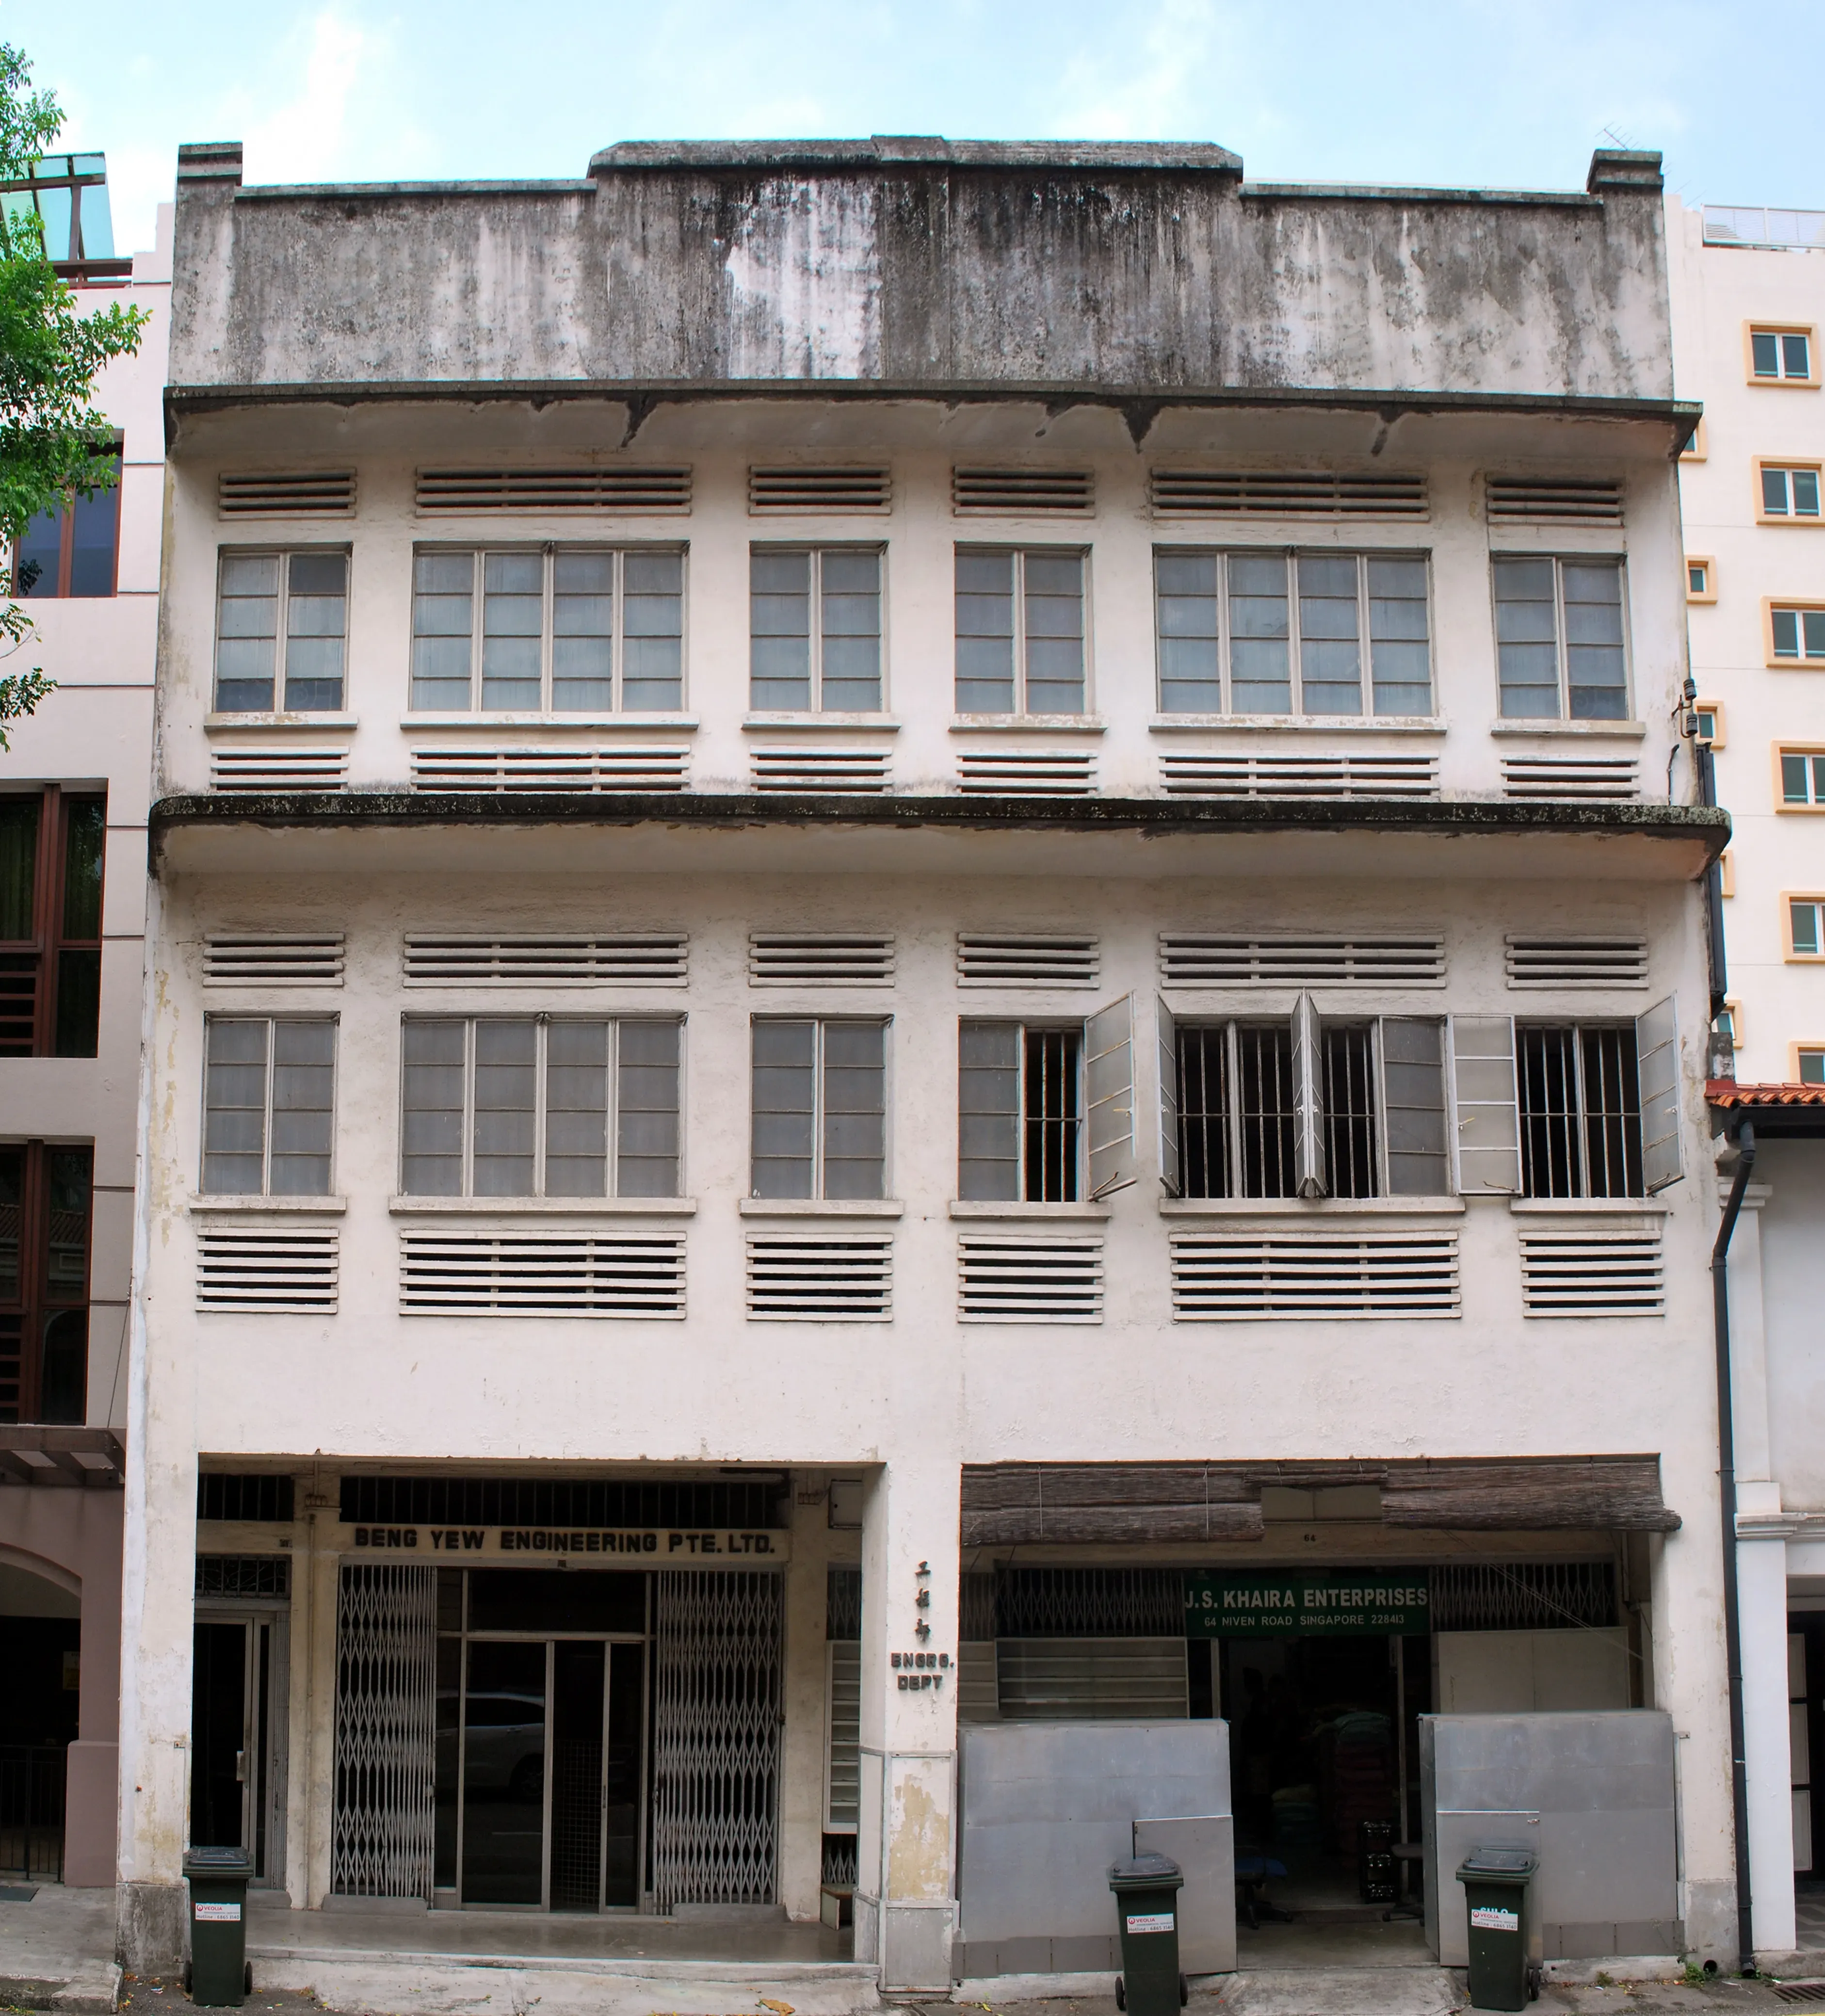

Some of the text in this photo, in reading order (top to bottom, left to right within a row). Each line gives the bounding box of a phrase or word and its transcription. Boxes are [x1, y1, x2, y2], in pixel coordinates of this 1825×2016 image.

[355, 1527, 775, 1553] BENG YEW ENGINEERING PTE. LTD.
[1185, 1587, 1428, 1609] J.S. KHAIRA ENTERPRISES
[1204, 1614, 1405, 1627] 64 NIVEN ROAD SINGAPORE 228413
[890, 1652, 955, 1668] ENGRG.
[897, 1675, 943, 1691] DEPT
